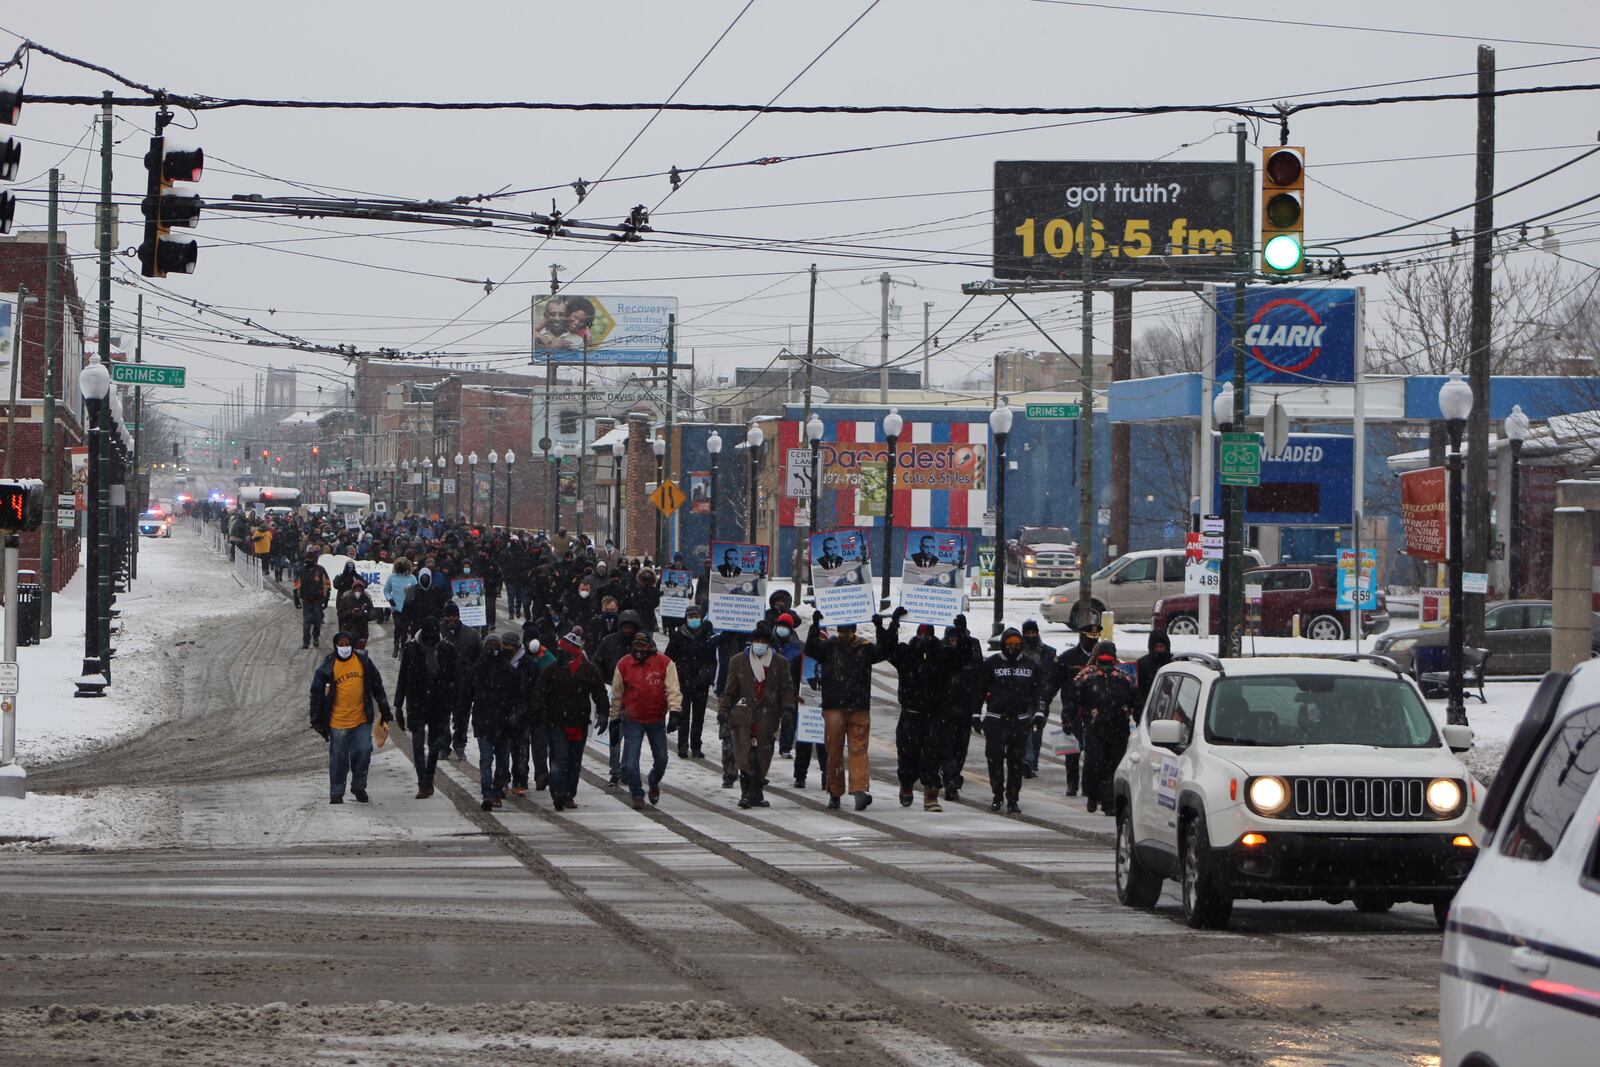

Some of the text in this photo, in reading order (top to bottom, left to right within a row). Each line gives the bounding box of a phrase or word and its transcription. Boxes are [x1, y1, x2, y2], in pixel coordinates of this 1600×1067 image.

[1066, 182, 1181, 207] got truth?
[1015, 217, 1232, 258] 106.5 fm
[617, 303, 668, 315] Recovery
[644, 316, 662, 324] drug
[626, 334, 668, 346] possibl
[1245, 324, 1327, 346] CLARK
[116, 368, 165, 382] GRIMES
[1028, 406, 1065, 416] GRIMES
[903, 472, 927, 484] Cuts
[928, 472, 936, 484] &
[940, 472, 970, 486] Styles
[11, 494, 22, 520] 4
[1402, 502, 1446, 512] WELCOME
[1403, 518, 1440, 528] WRIGHT-
[1404, 525, 1439, 536] DUNBAR
[1404, 532, 1444, 546] HISTORIC
[1406, 540, 1442, 554] DISTRICT
[1200, 575, 1218, 586] 489
